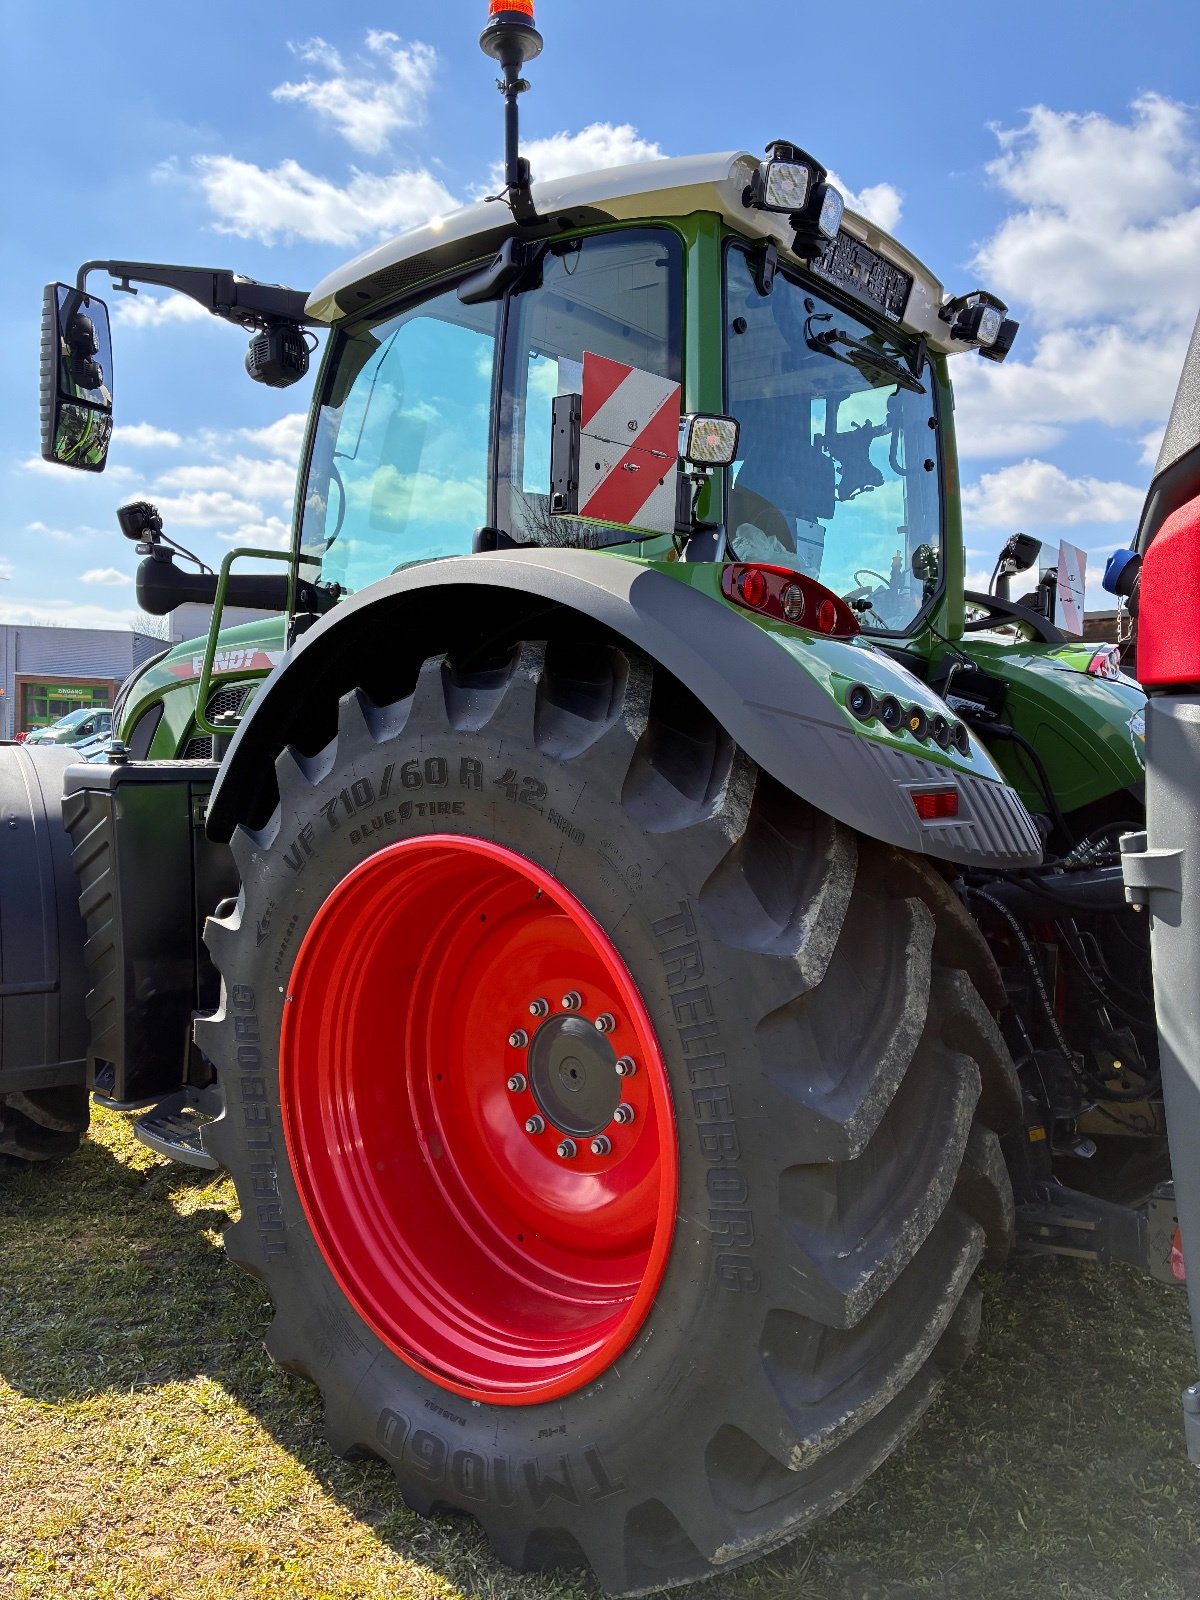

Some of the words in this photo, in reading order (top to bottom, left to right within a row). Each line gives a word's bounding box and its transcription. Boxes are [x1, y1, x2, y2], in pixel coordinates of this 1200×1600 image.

[192, 648, 258, 675] FNDT
[282, 822, 315, 874] VF
[320, 756, 449, 832] 710/60
[459, 756, 484, 792] R
[495, 768, 548, 808] 42
[232, 984, 288, 1263] TRELLEBORG
[650, 898, 762, 1295] TRELLEBORG
[376, 1406, 628, 1512] TM1060
